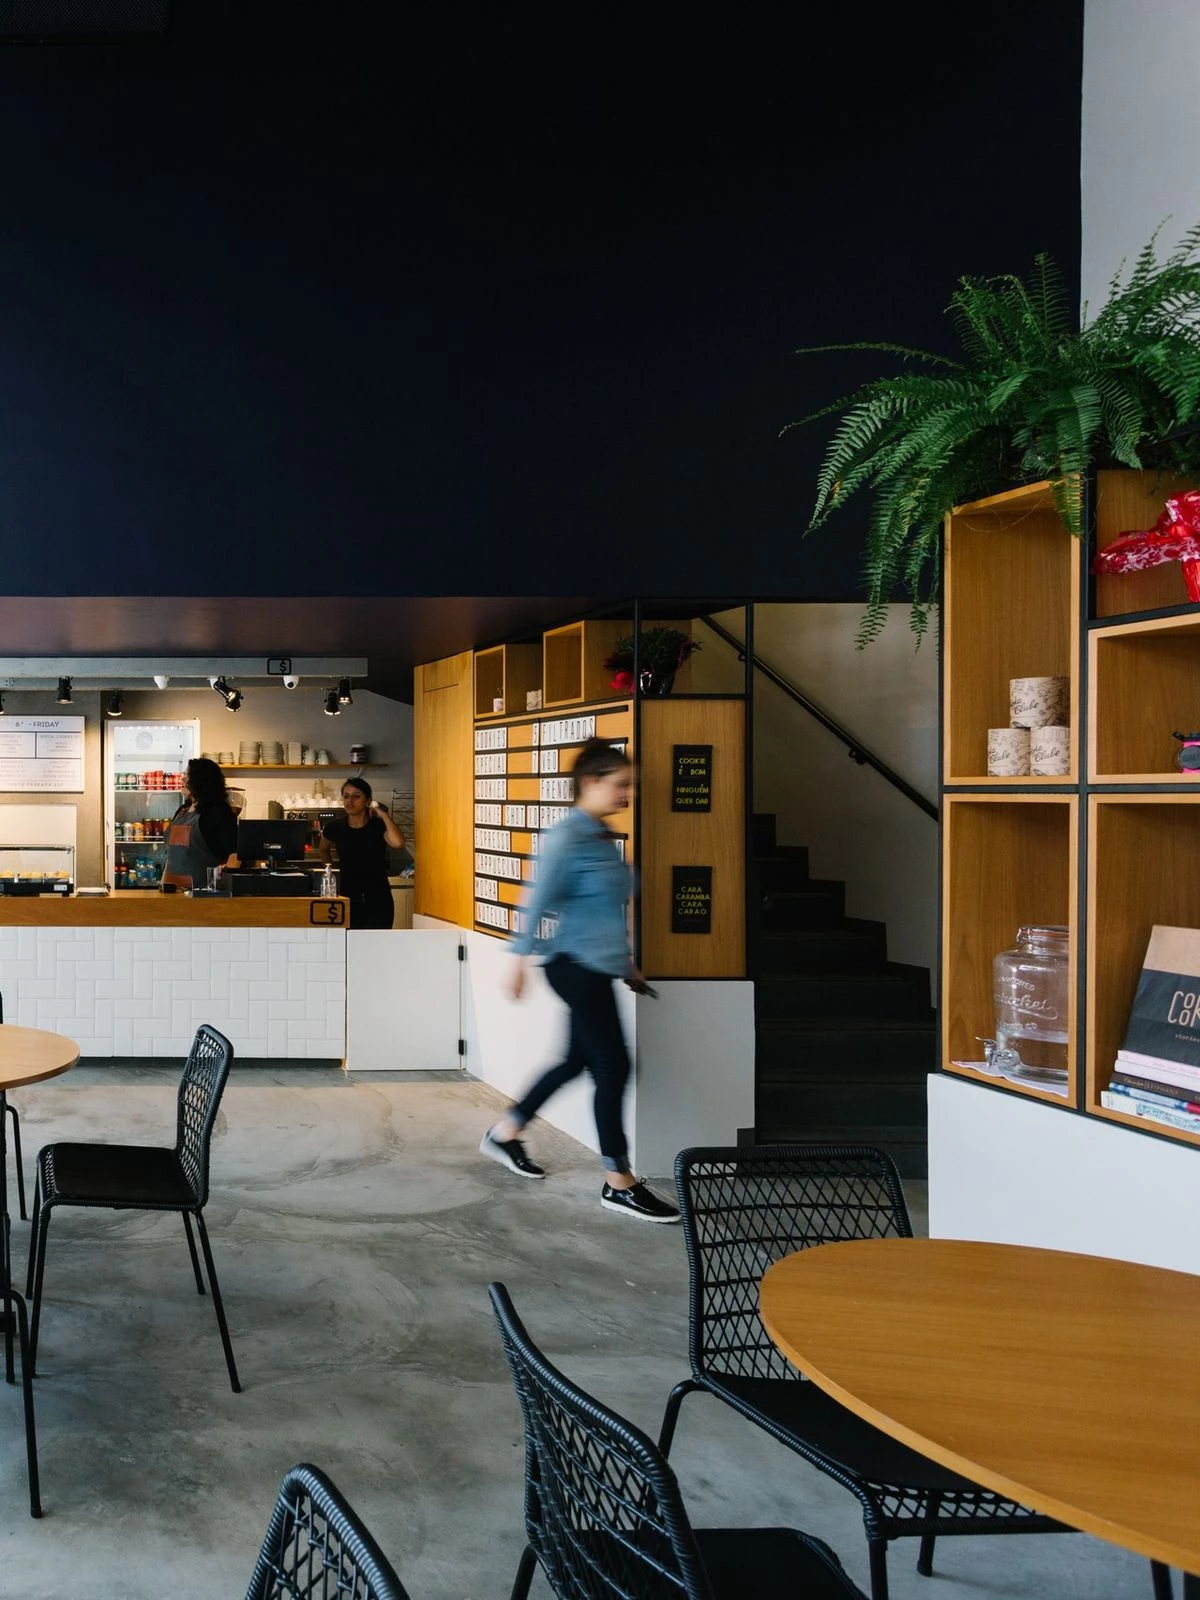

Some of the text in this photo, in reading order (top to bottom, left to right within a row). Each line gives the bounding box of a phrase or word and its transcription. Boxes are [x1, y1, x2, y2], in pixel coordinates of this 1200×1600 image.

[543, 717, 594, 743] FILTRADOS
[679, 757, 706, 765] COOKIE
[676, 783, 709, 793] NINGUÉM
[675, 797, 709, 805] QUER DAR
